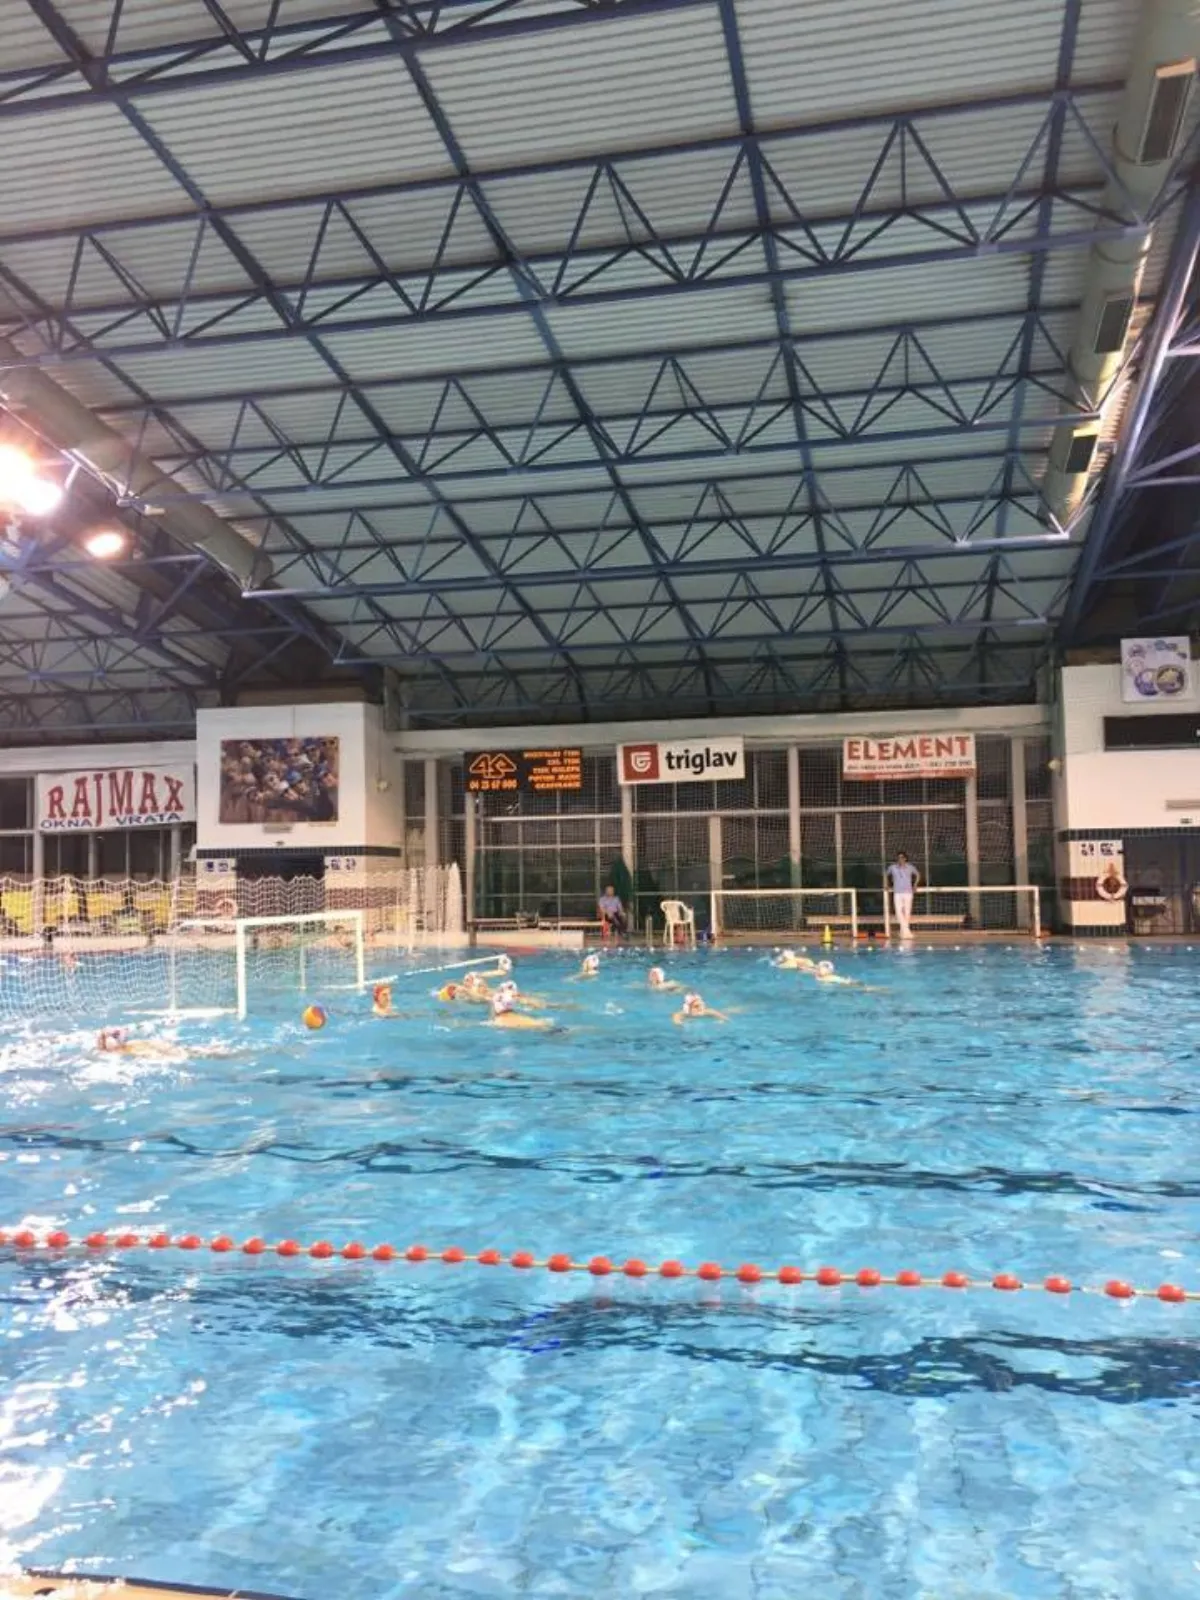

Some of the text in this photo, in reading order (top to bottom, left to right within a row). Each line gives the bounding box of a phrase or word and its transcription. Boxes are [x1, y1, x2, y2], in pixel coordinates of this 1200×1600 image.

[665, 747, 737, 775] triglav
[847, 736, 970, 760] ELEMENT
[48, 771, 184, 827] RAJMAX
[41, 812, 181, 829] OKNA VRATA
